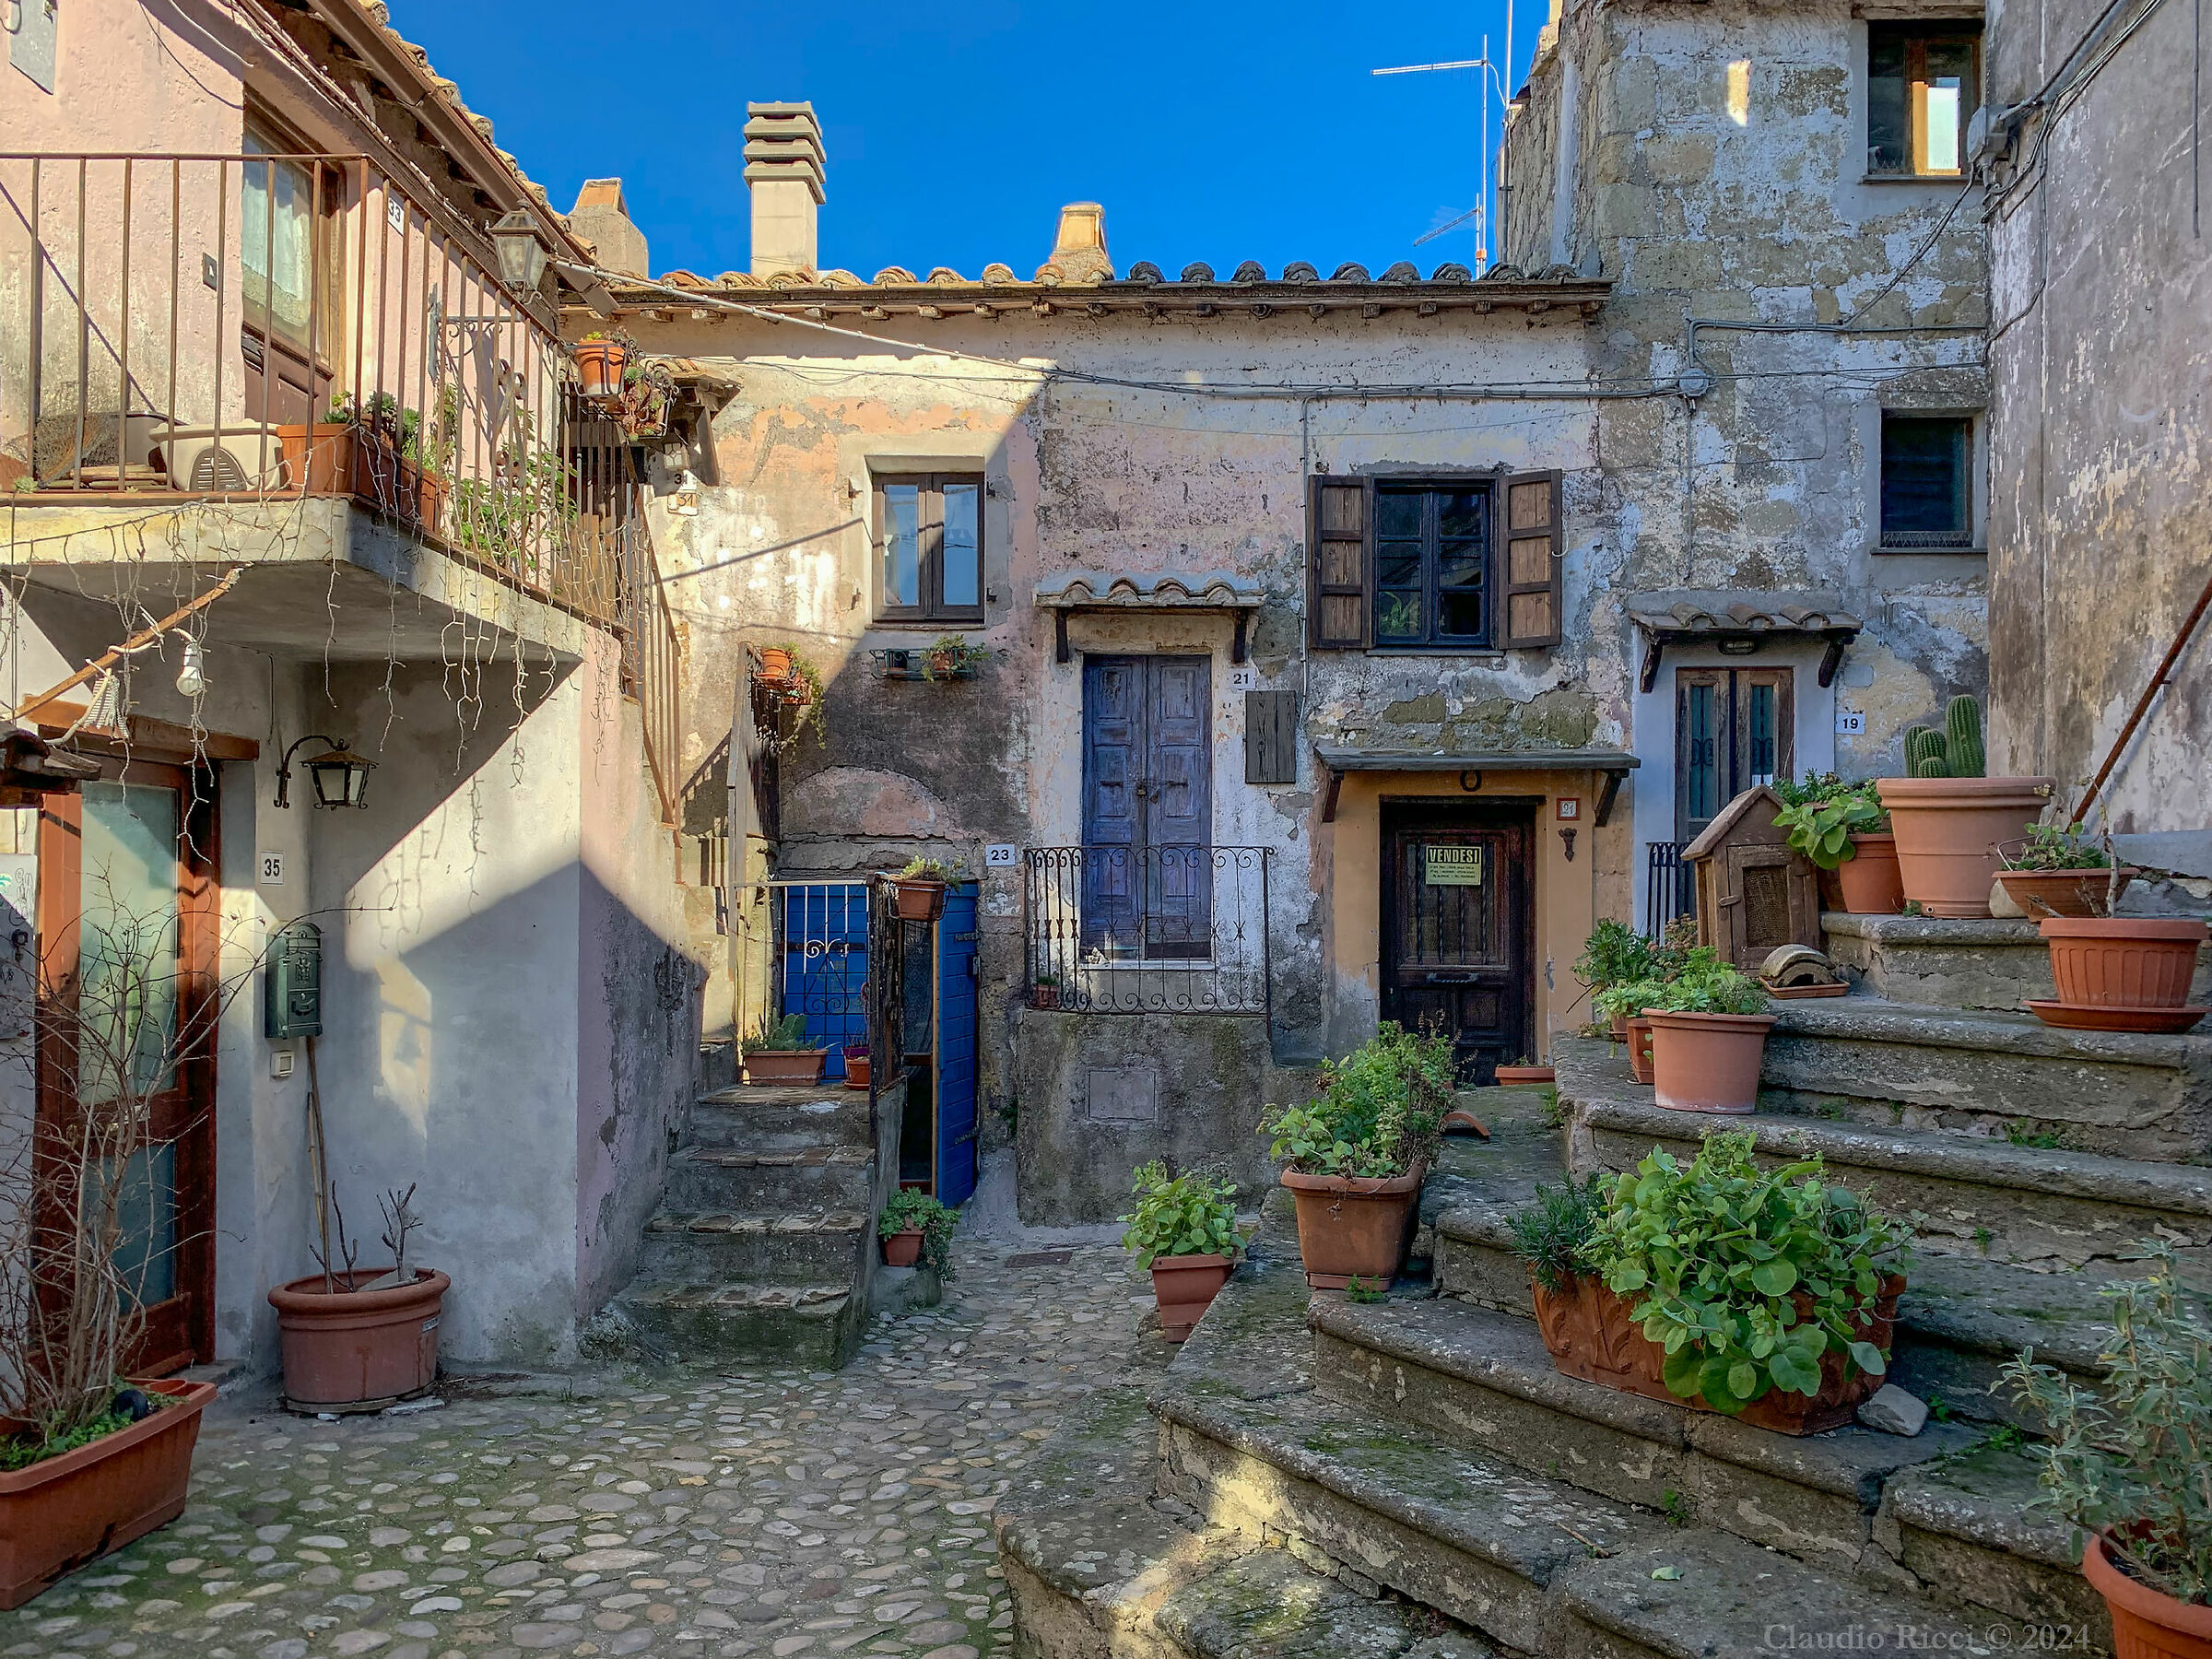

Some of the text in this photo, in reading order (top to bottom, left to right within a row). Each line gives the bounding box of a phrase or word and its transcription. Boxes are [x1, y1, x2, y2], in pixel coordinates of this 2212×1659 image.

[388, 199, 401, 223] 33
[674, 473, 688, 485] 31
[1233, 673, 1249, 685] 21
[1843, 718, 1859, 729] 19
[991, 849, 1009, 861] 23
[1429, 848, 1478, 864] VENDESI
[265, 858, 280, 877] 35
